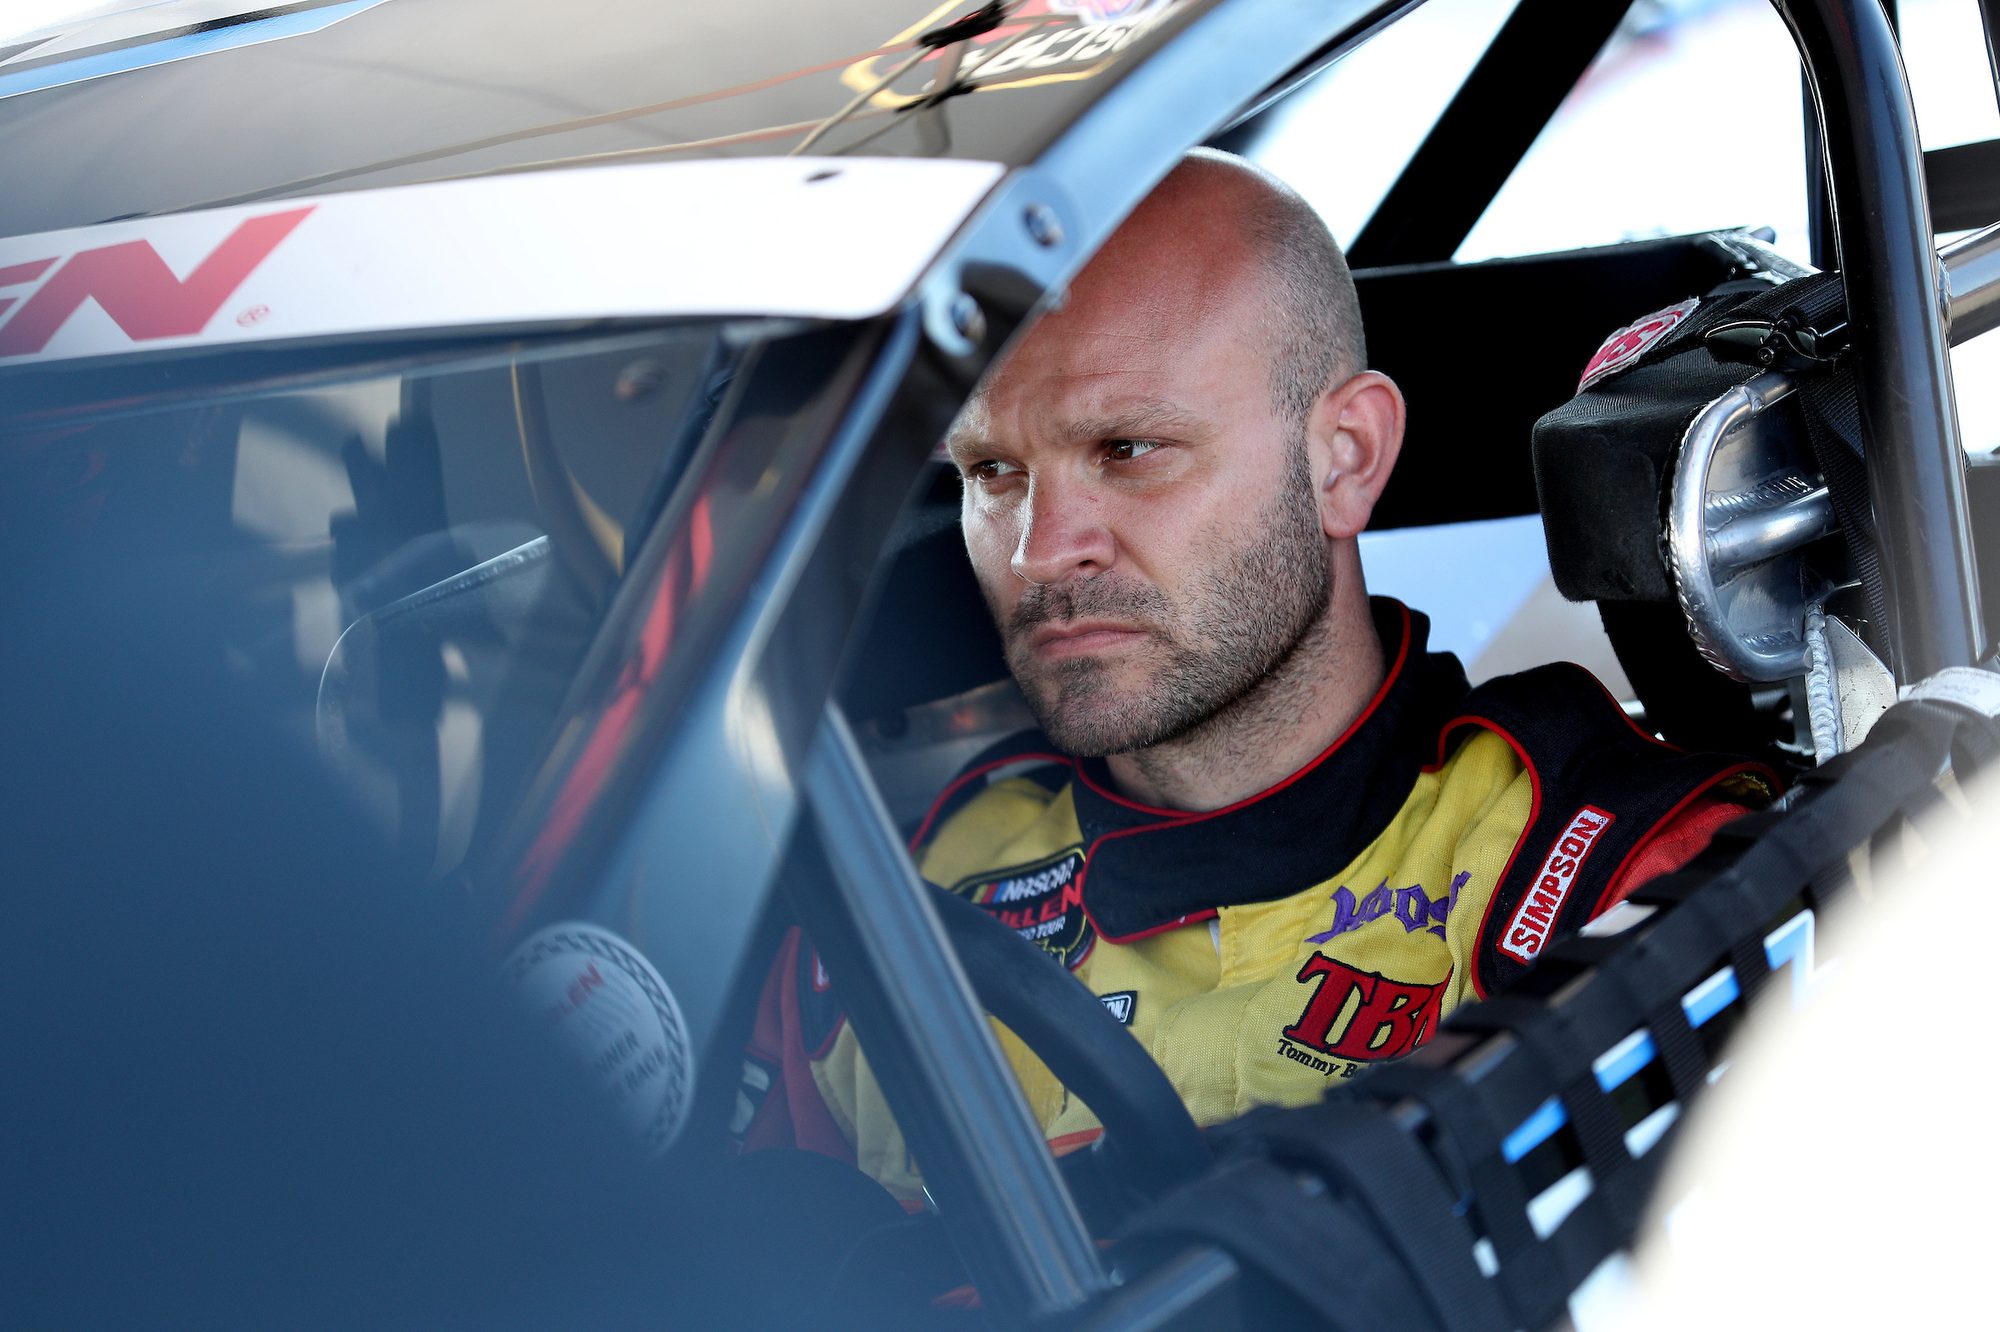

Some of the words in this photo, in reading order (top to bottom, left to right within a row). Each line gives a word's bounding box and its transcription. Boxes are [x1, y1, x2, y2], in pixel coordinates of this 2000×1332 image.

[1001, 857, 1075, 903] NASCAR
[1511, 816, 1600, 953] SIMPSON
[1036, 915, 1066, 939] TOUR
[1276, 1038, 1341, 1077] Tommy
